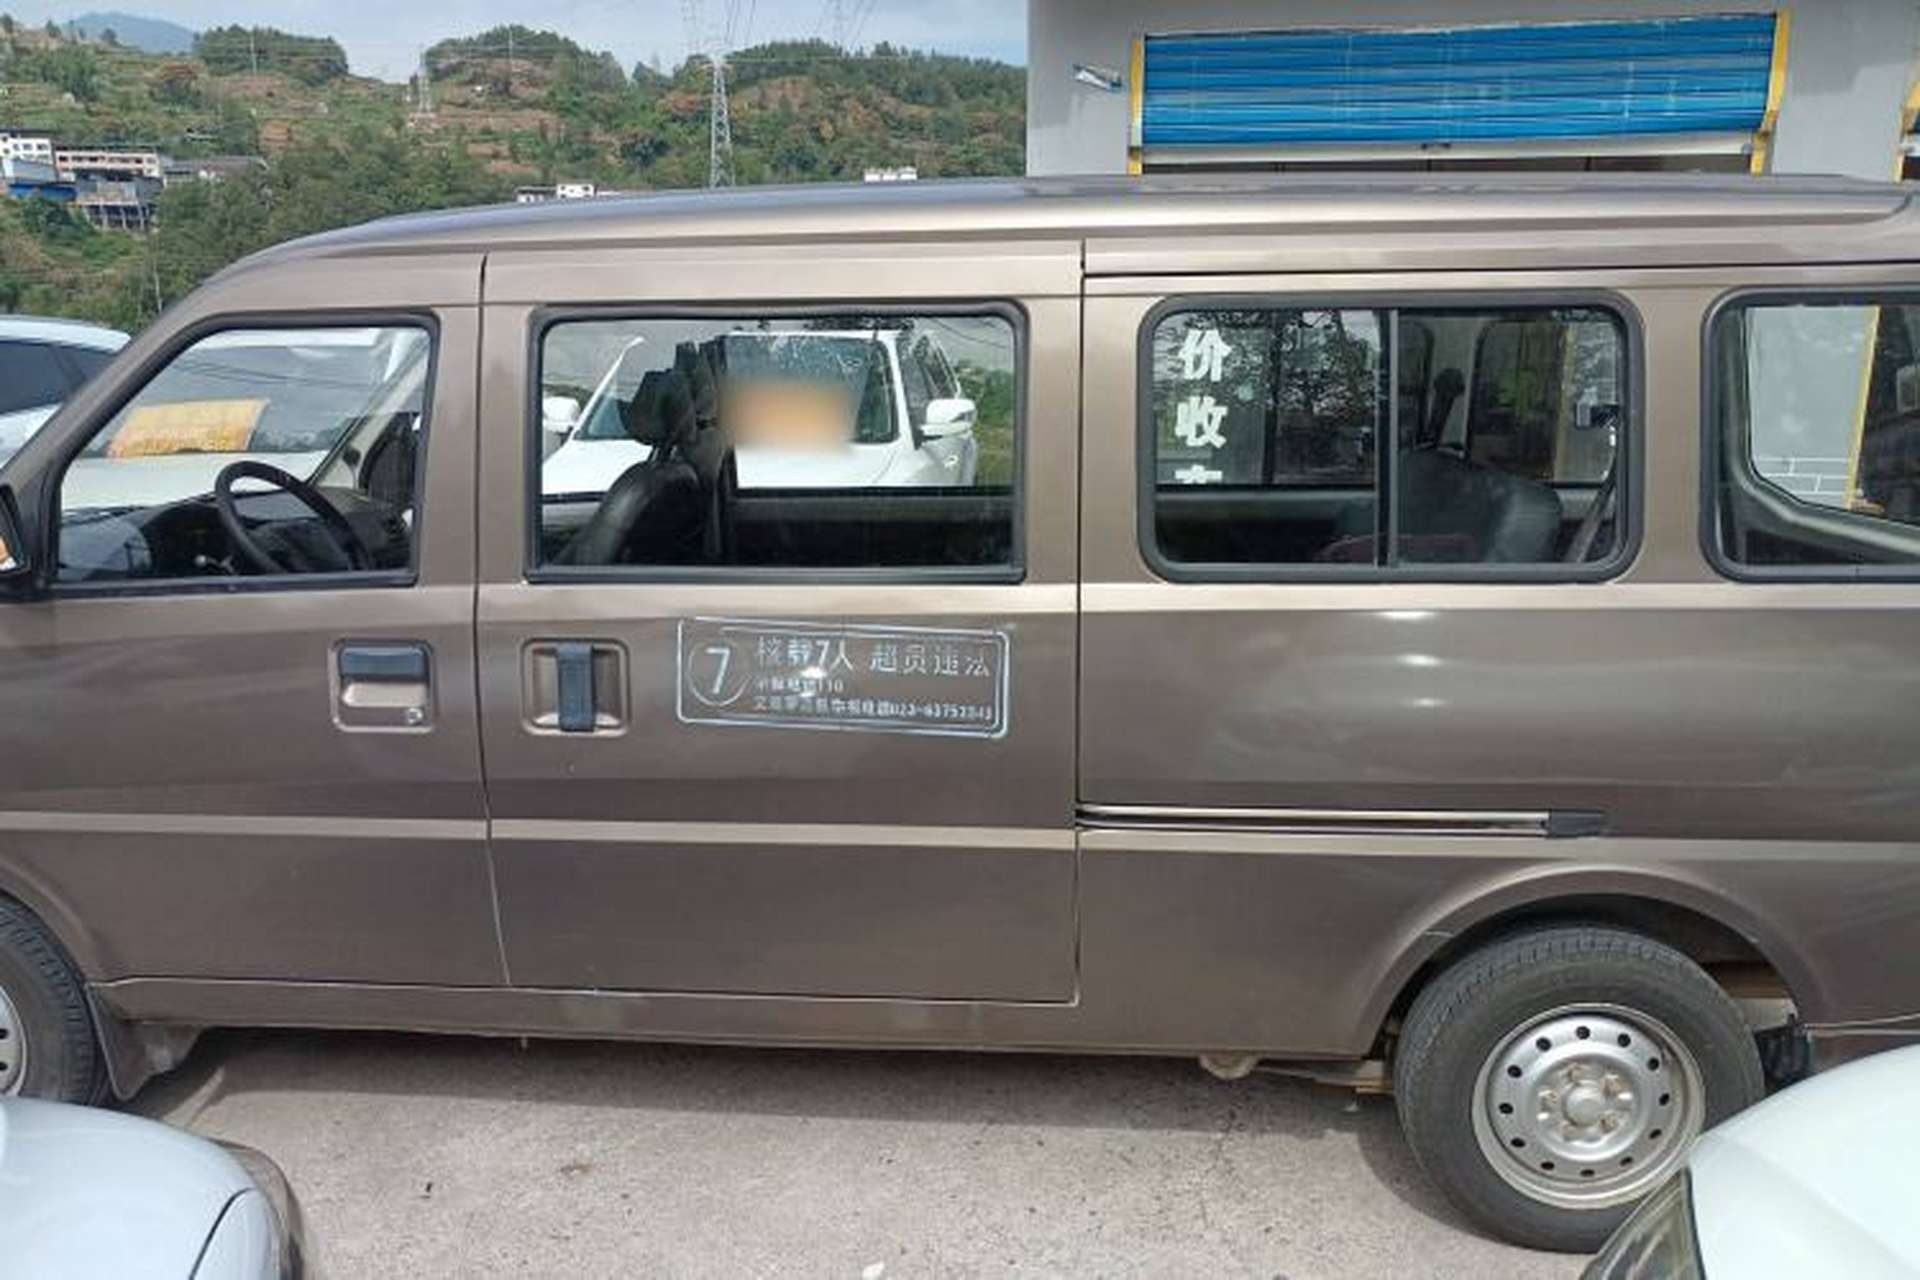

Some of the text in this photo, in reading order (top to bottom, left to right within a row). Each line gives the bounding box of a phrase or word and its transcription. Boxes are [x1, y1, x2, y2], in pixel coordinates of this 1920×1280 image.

[705, 647, 731, 694] 7
[869, 643, 990, 677] 超员违法
